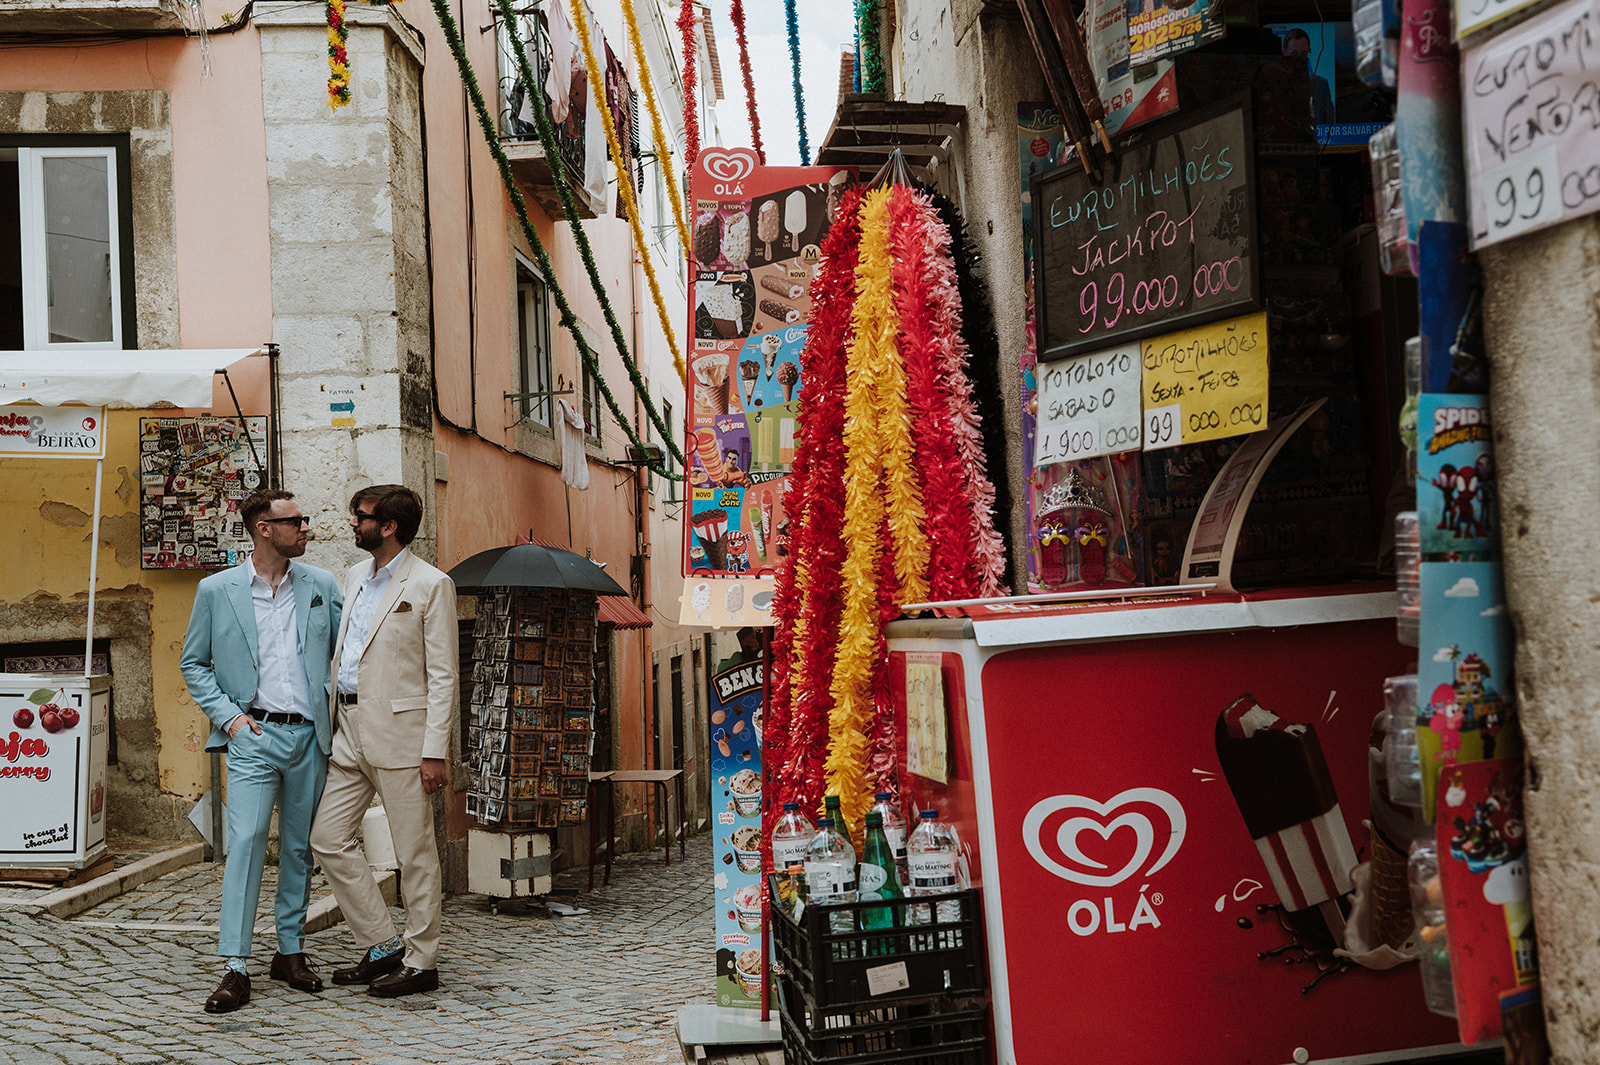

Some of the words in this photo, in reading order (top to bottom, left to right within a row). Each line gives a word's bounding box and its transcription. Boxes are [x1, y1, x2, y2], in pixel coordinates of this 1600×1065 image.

[1151, 5, 1168, 16] BIDU
[1130, 20, 1202, 53] 2025/26
[1325, 127, 1340, 136] POR
[1342, 125, 1372, 136] SALVAR
[1050, 134, 1234, 231] EUROMILHÕES
[1072, 195, 1205, 275] JACKPOT
[1143, 323, 1258, 373] EUROMILHÕES
[1043, 354, 1131, 393] TOTOLOTO
[1048, 388, 1115, 422] SABADO
[38, 434, 96, 448] BEIRÃO
[718, 666, 754, 698] BEN
[36, 828, 56, 838] cup
[58, 822, 68, 833] of
